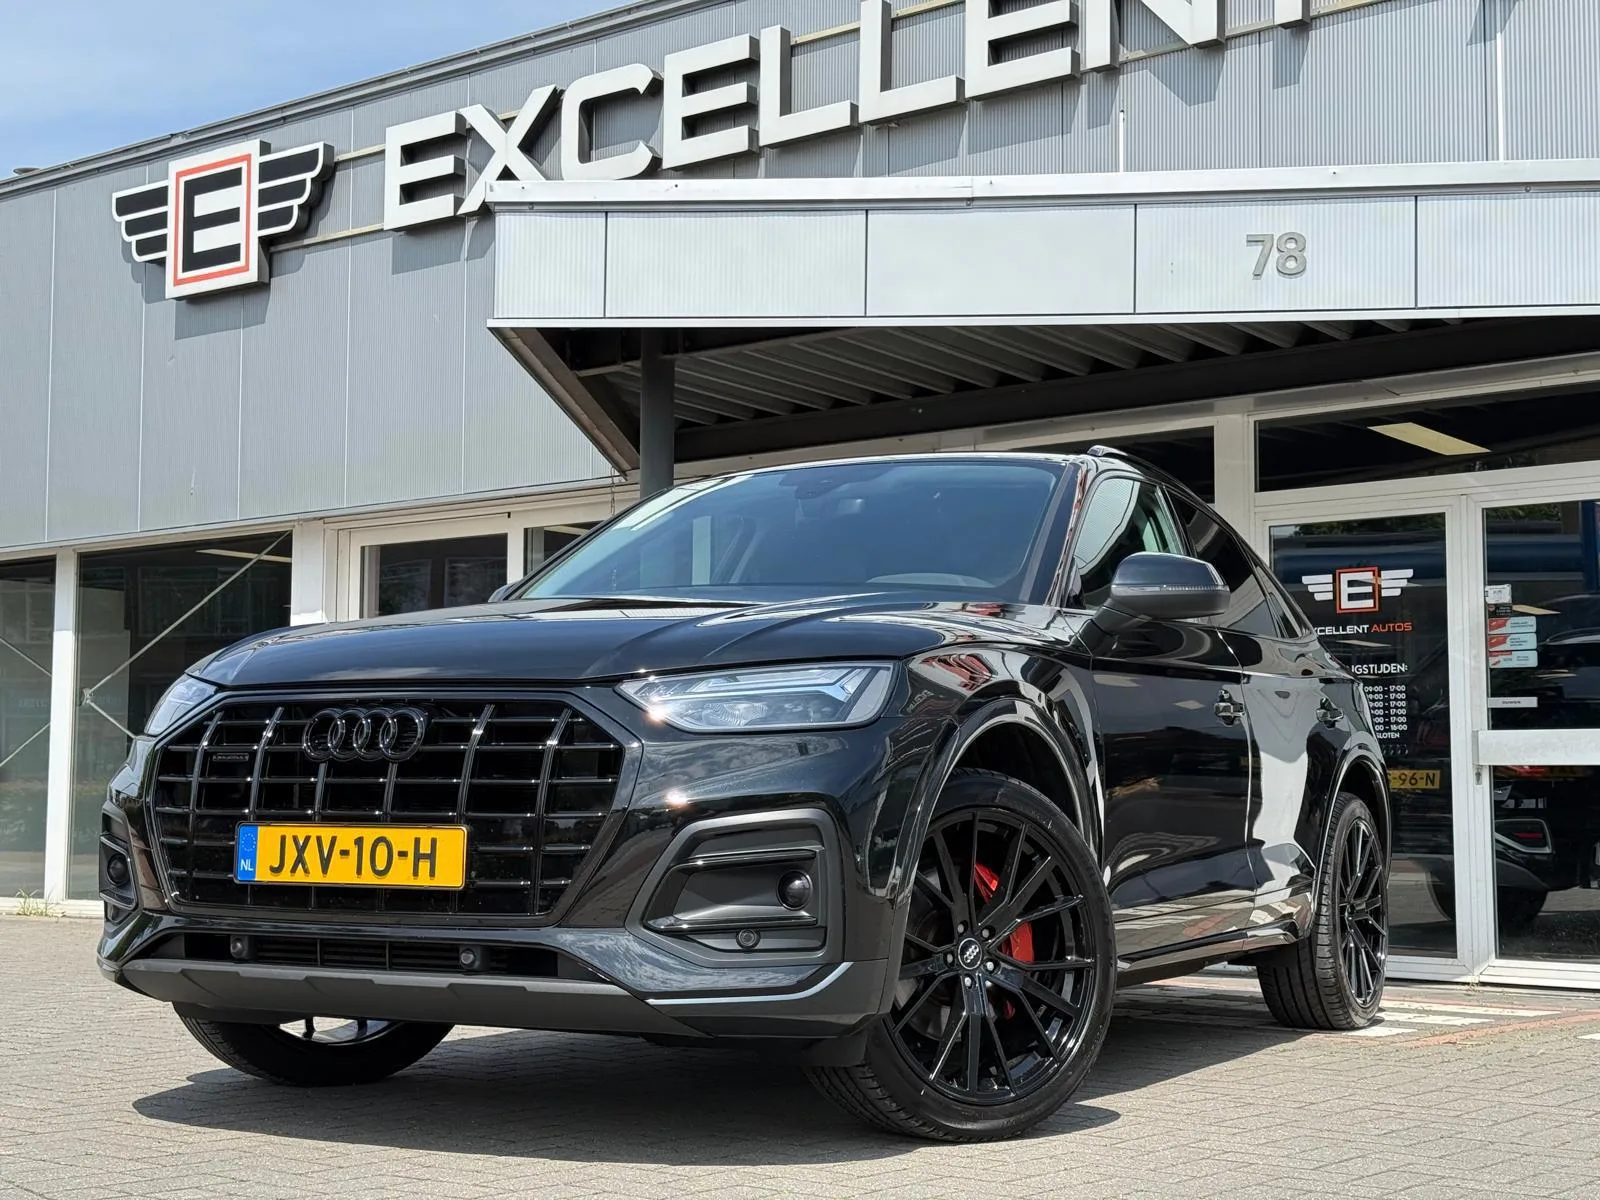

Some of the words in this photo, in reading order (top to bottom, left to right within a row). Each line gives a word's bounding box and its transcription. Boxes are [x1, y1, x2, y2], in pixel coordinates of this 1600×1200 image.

[383, 0, 1310, 231] EXCELLEN
[182, 166, 243, 273] E
[1246, 231, 1307, 280] 78
[1340, 571, 1374, 609] E
[1371, 622, 1412, 633] AUTOS
[240, 859, 254, 871] NL
[269, 834, 438, 879] JXV-10-H
